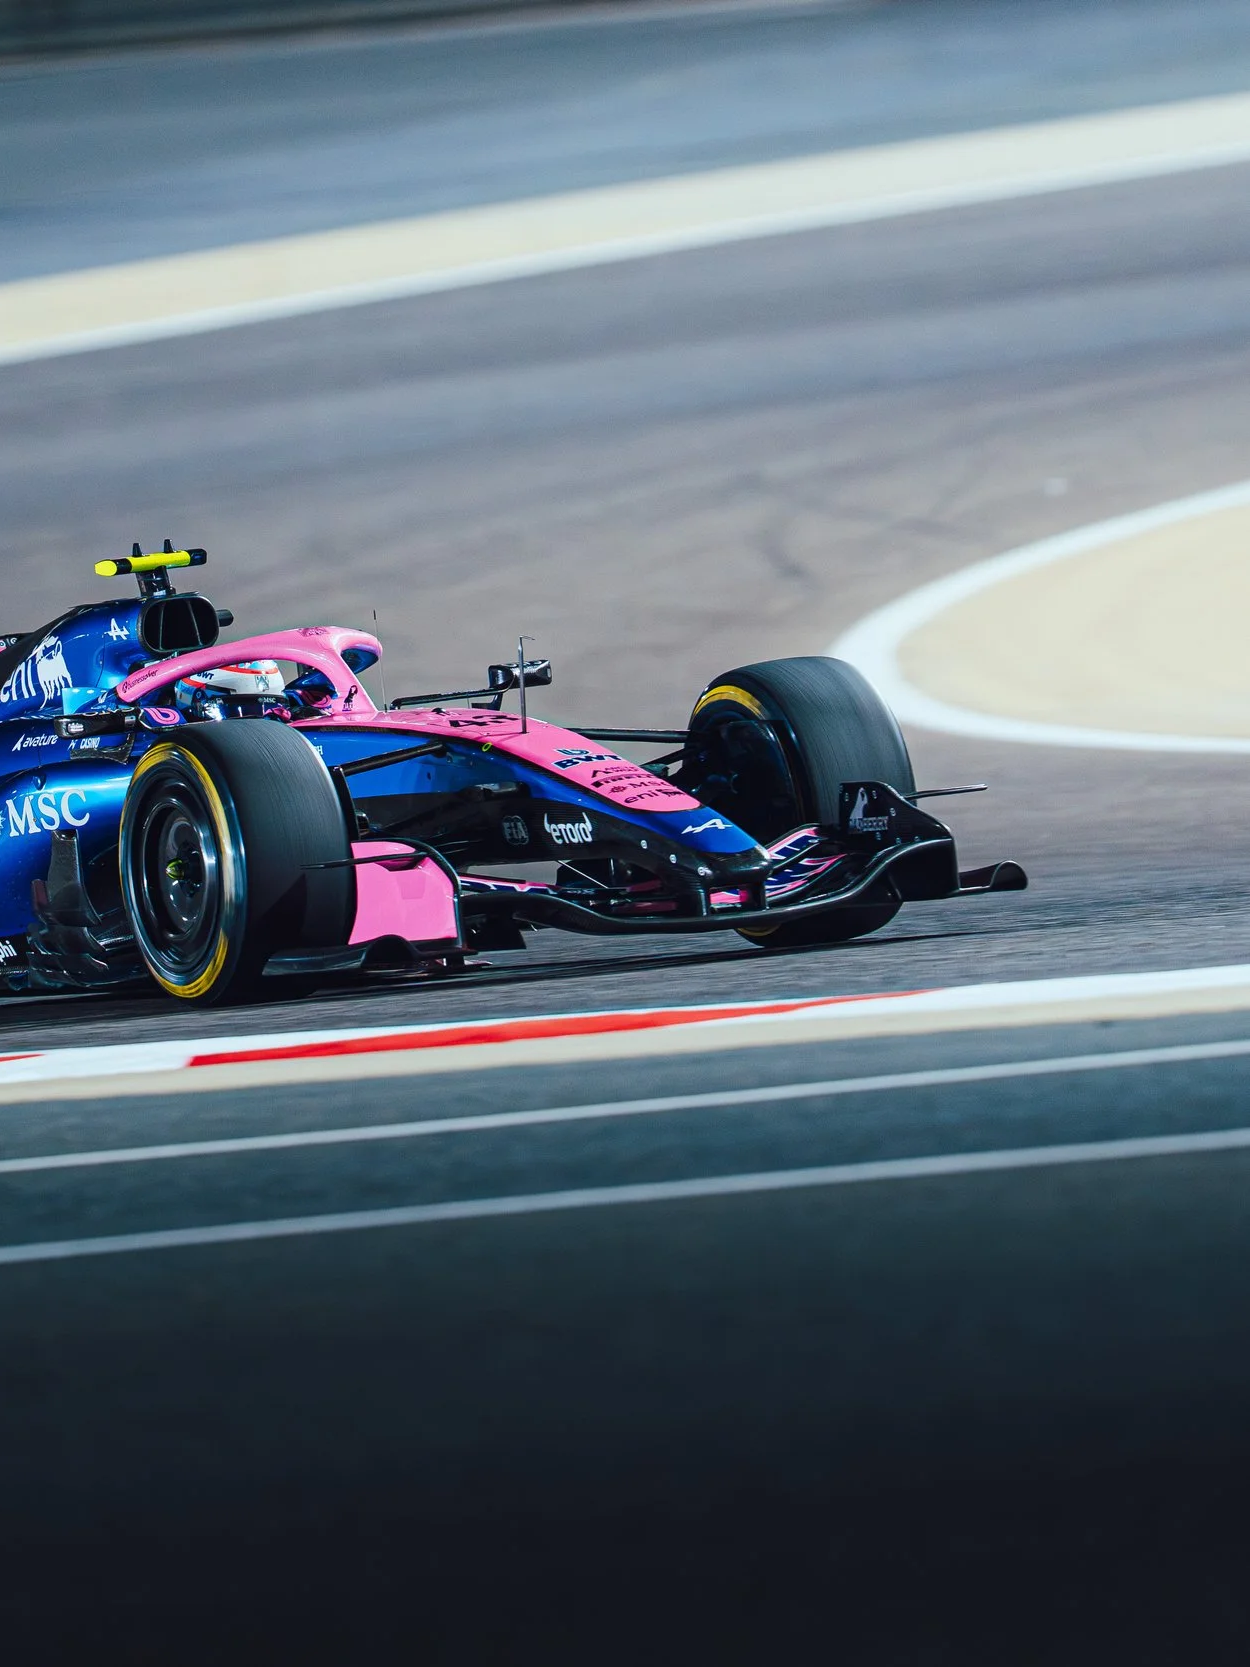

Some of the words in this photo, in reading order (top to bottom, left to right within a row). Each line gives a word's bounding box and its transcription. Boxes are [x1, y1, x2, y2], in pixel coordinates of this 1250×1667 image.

[23, 733, 59, 748] avature
[553, 754, 622, 769] BWT
[623, 790, 658, 804] eni
[6, 789, 90, 837] MSC
